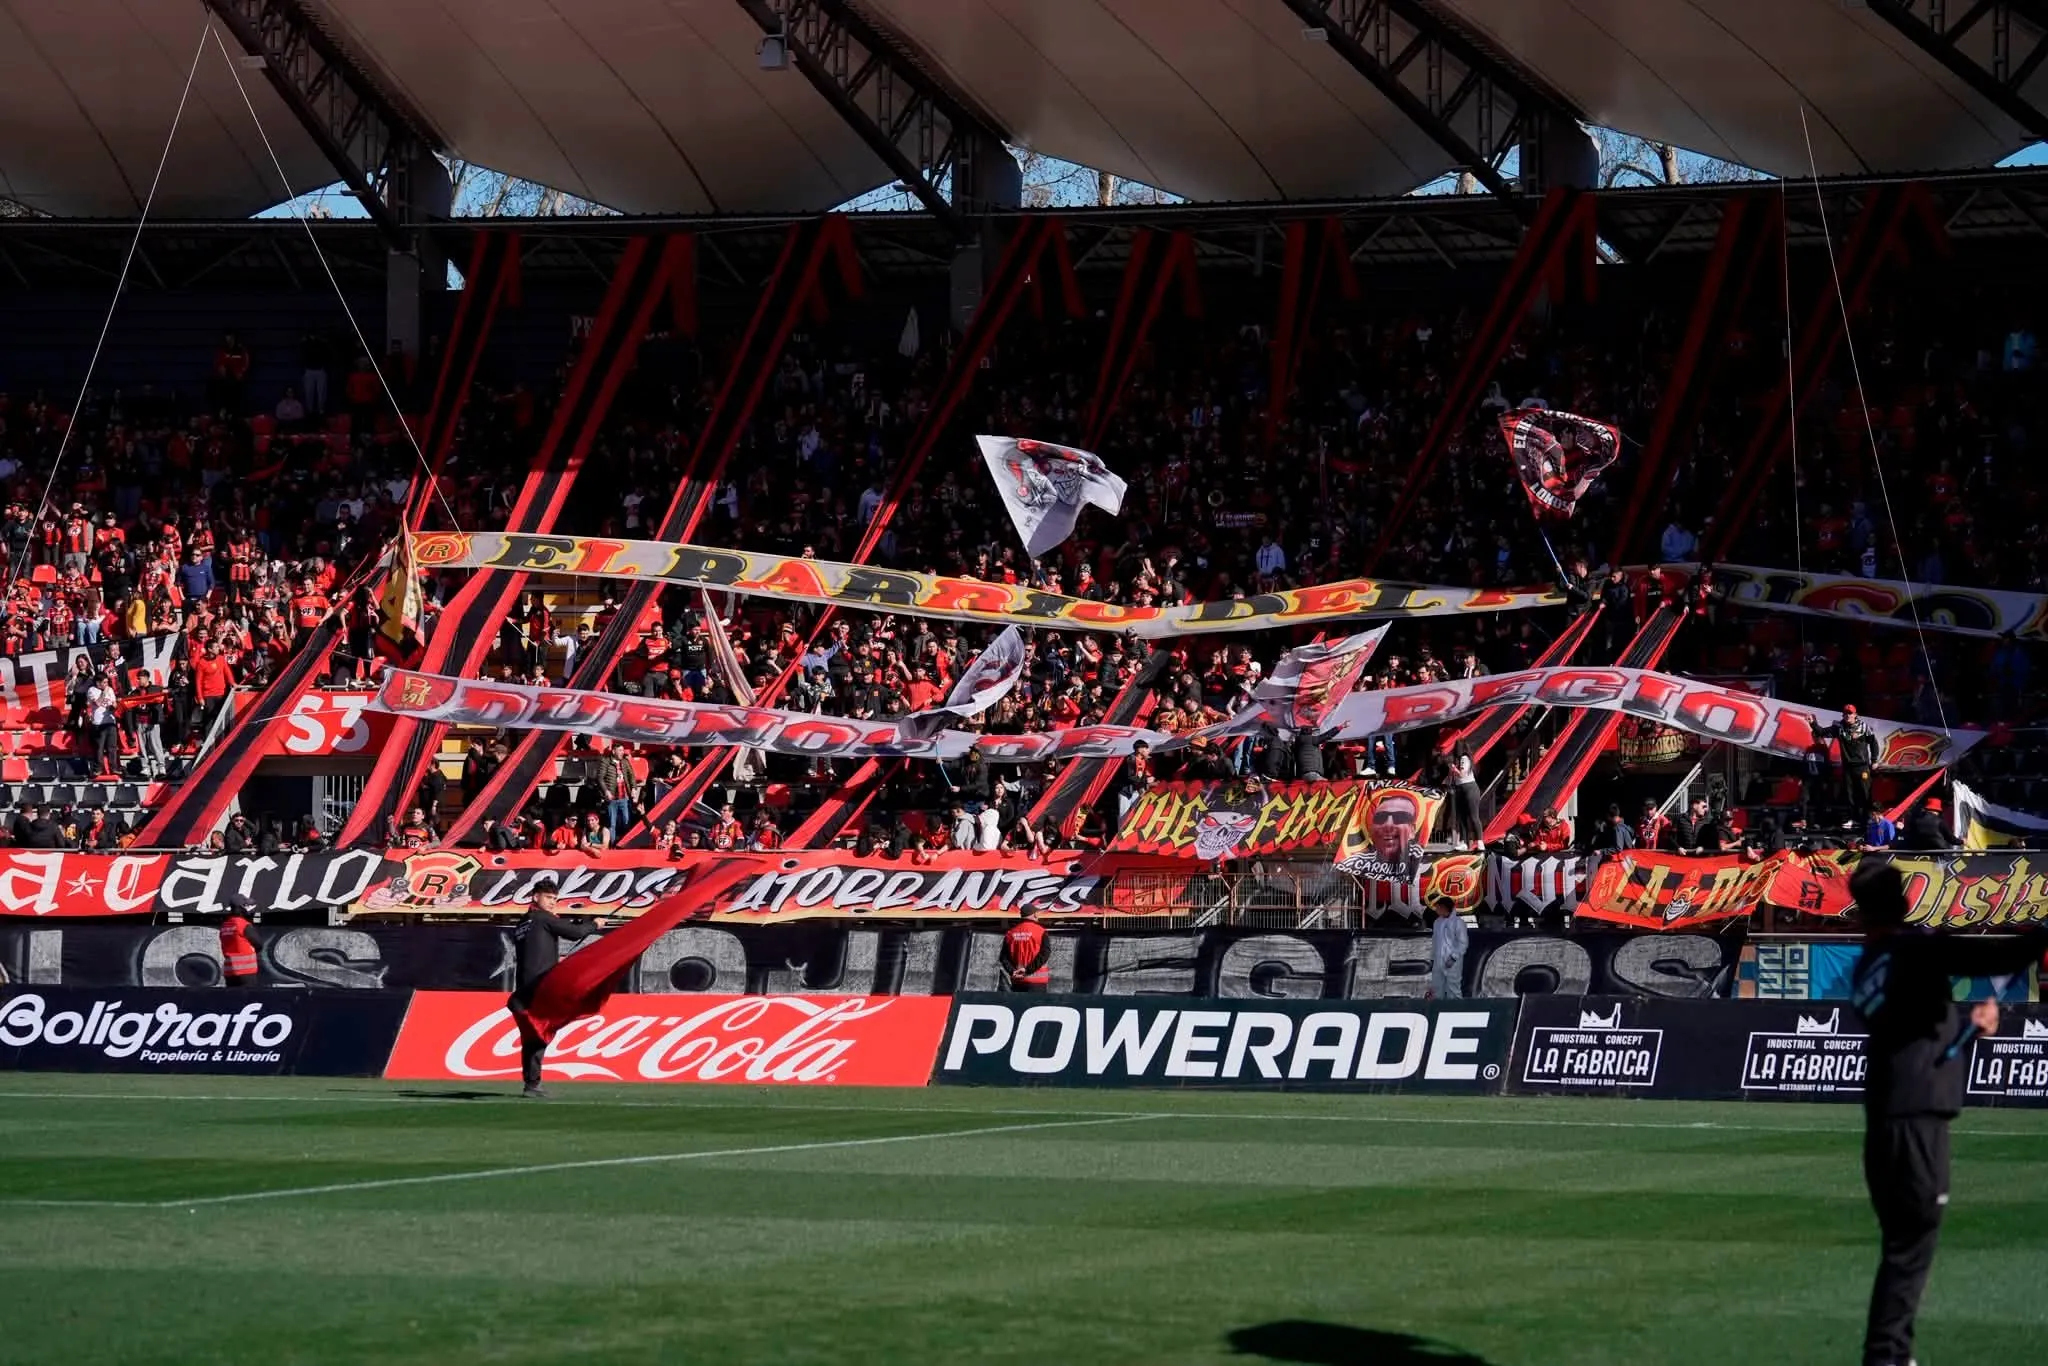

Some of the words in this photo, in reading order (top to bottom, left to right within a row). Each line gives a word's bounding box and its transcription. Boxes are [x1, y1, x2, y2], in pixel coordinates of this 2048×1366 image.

[487, 534, 637, 575] EL
[285, 694, 370, 753] S3
[1121, 791, 1208, 849] THE
[480, 865, 677, 908] LOKOS
[725, 866, 1095, 914] ATORRANTES
[1603, 859, 1671, 918] LA
[0, 993, 292, 1057] Bolígrafo
[943, 1003, 1489, 1081] POWERADE
[1550, 1033, 1598, 1045] INDUSTRIAL
[1605, 1034, 1643, 1046] CONCEPT
[140, 1050, 208, 1064] Papelería
[212, 1050, 223, 1062] &
[226, 1050, 280, 1062] Librería
[1532, 1047, 1559, 1073] LA
[1767, 1038, 1816, 1050] INDUSTRIAL
[1823, 1039, 1862, 1051] CONCEPT
[1993, 1043, 2044, 1055] INDUSTRIAL
[1750, 1053, 1777, 1080] LA
[1975, 1058, 2003, 1084] LA
